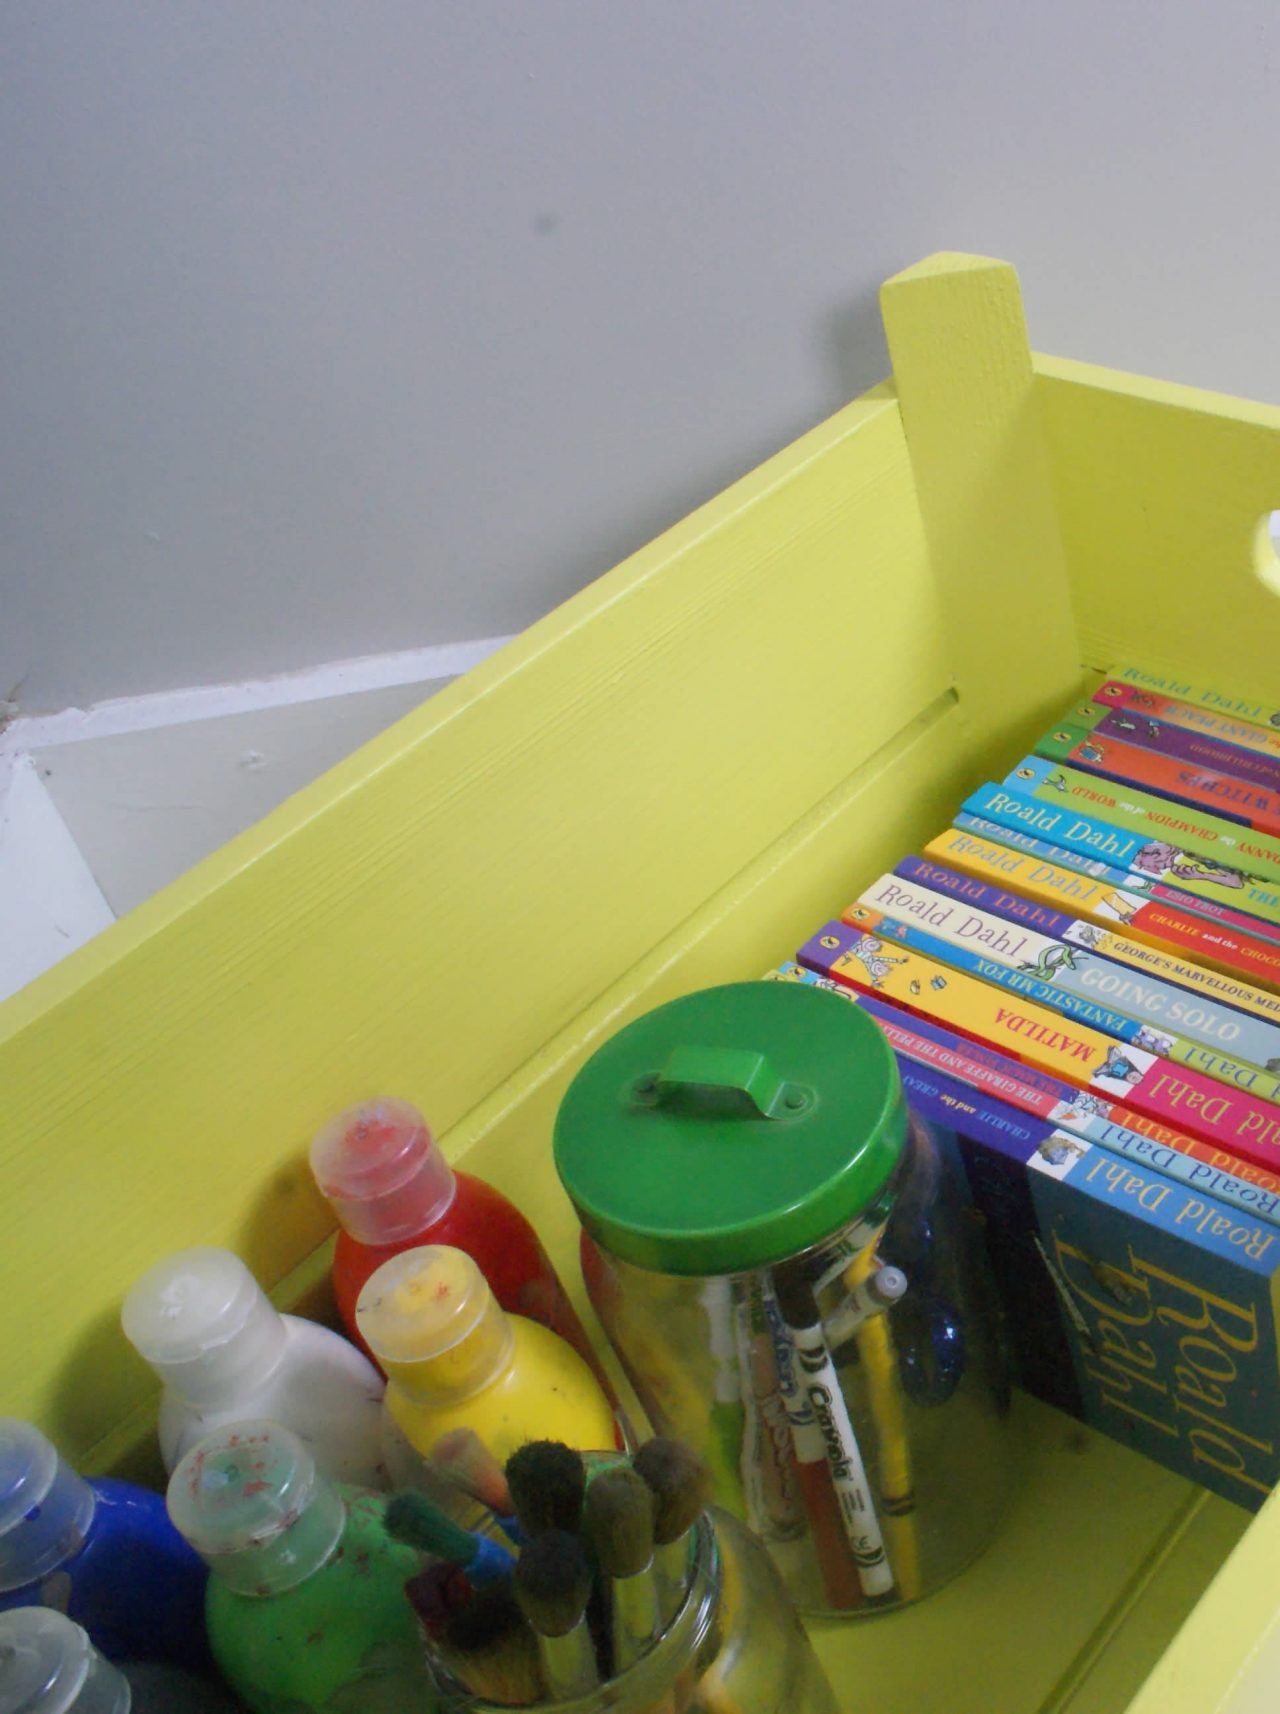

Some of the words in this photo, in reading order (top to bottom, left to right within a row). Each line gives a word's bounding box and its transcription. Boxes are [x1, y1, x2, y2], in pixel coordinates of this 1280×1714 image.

[1123, 666, 1191, 695] Roald
[1201, 691, 1261, 717] Dahl
[1220, 722, 1268, 744] GIANT
[1072, 786, 1118, 808] WORLD
[1176, 771, 1270, 811] WITCHES
[984, 793, 1061, 831] Roald
[1065, 820, 1136, 858] Dahl
[1144, 811, 1218, 841] CHAMPION
[1220, 834, 1236, 846] the
[948, 834, 1025, 873] Roald
[1027, 863, 1099, 902] Dahl
[914, 862, 985, 899] Roald
[996, 894, 1060, 928] Dahl
[1166, 888, 1192, 905] ESIO
[1194, 897, 1227, 917] TROT
[1248, 887, 1280, 909] THE
[875, 883, 953, 928] Roald
[954, 915, 1029, 956] Dahl
[1150, 912, 1201, 936] CHARLIE
[1201, 932, 1220, 945] and
[1221, 937, 1238, 950] the
[974, 959, 1010, 981] FOX
[1009, 975, 1031, 992] MR
[1112, 940, 1172, 970] GEORGE'S
[1170, 963, 1255, 1000] MARVELLOUS
[1032, 986, 1127, 1033] FANTASTIC
[1080, 966, 1168, 1010] GOING
[1165, 1001, 1241, 1042] SOLO
[916, 1042, 939, 1059] THE
[995, 1007, 1097, 1062] MATILDA
[938, 1052, 966, 1070] AND
[966, 1064, 1016, 1092] GIRAFFE
[1183, 1046, 1260, 1088] Dahl
[940, 1094, 957, 1106] the
[956, 1101, 976, 1114] and
[1016, 1085, 1043, 1106] THE
[1149, 1073, 1233, 1126] Dahl
[978, 1111, 1031, 1141] CHARLIE
[1100, 1123, 1175, 1168] Dahl
[1120, 1114, 1203, 1157] Dahl
[1086, 1157, 1174, 1212] Dahl
[1175, 1200, 1275, 1261] Roald
[1052, 1228, 1178, 1437] Dahl
[1128, 1243, 1275, 1494] Roald
[808, 1385, 852, 1482] Crayola
